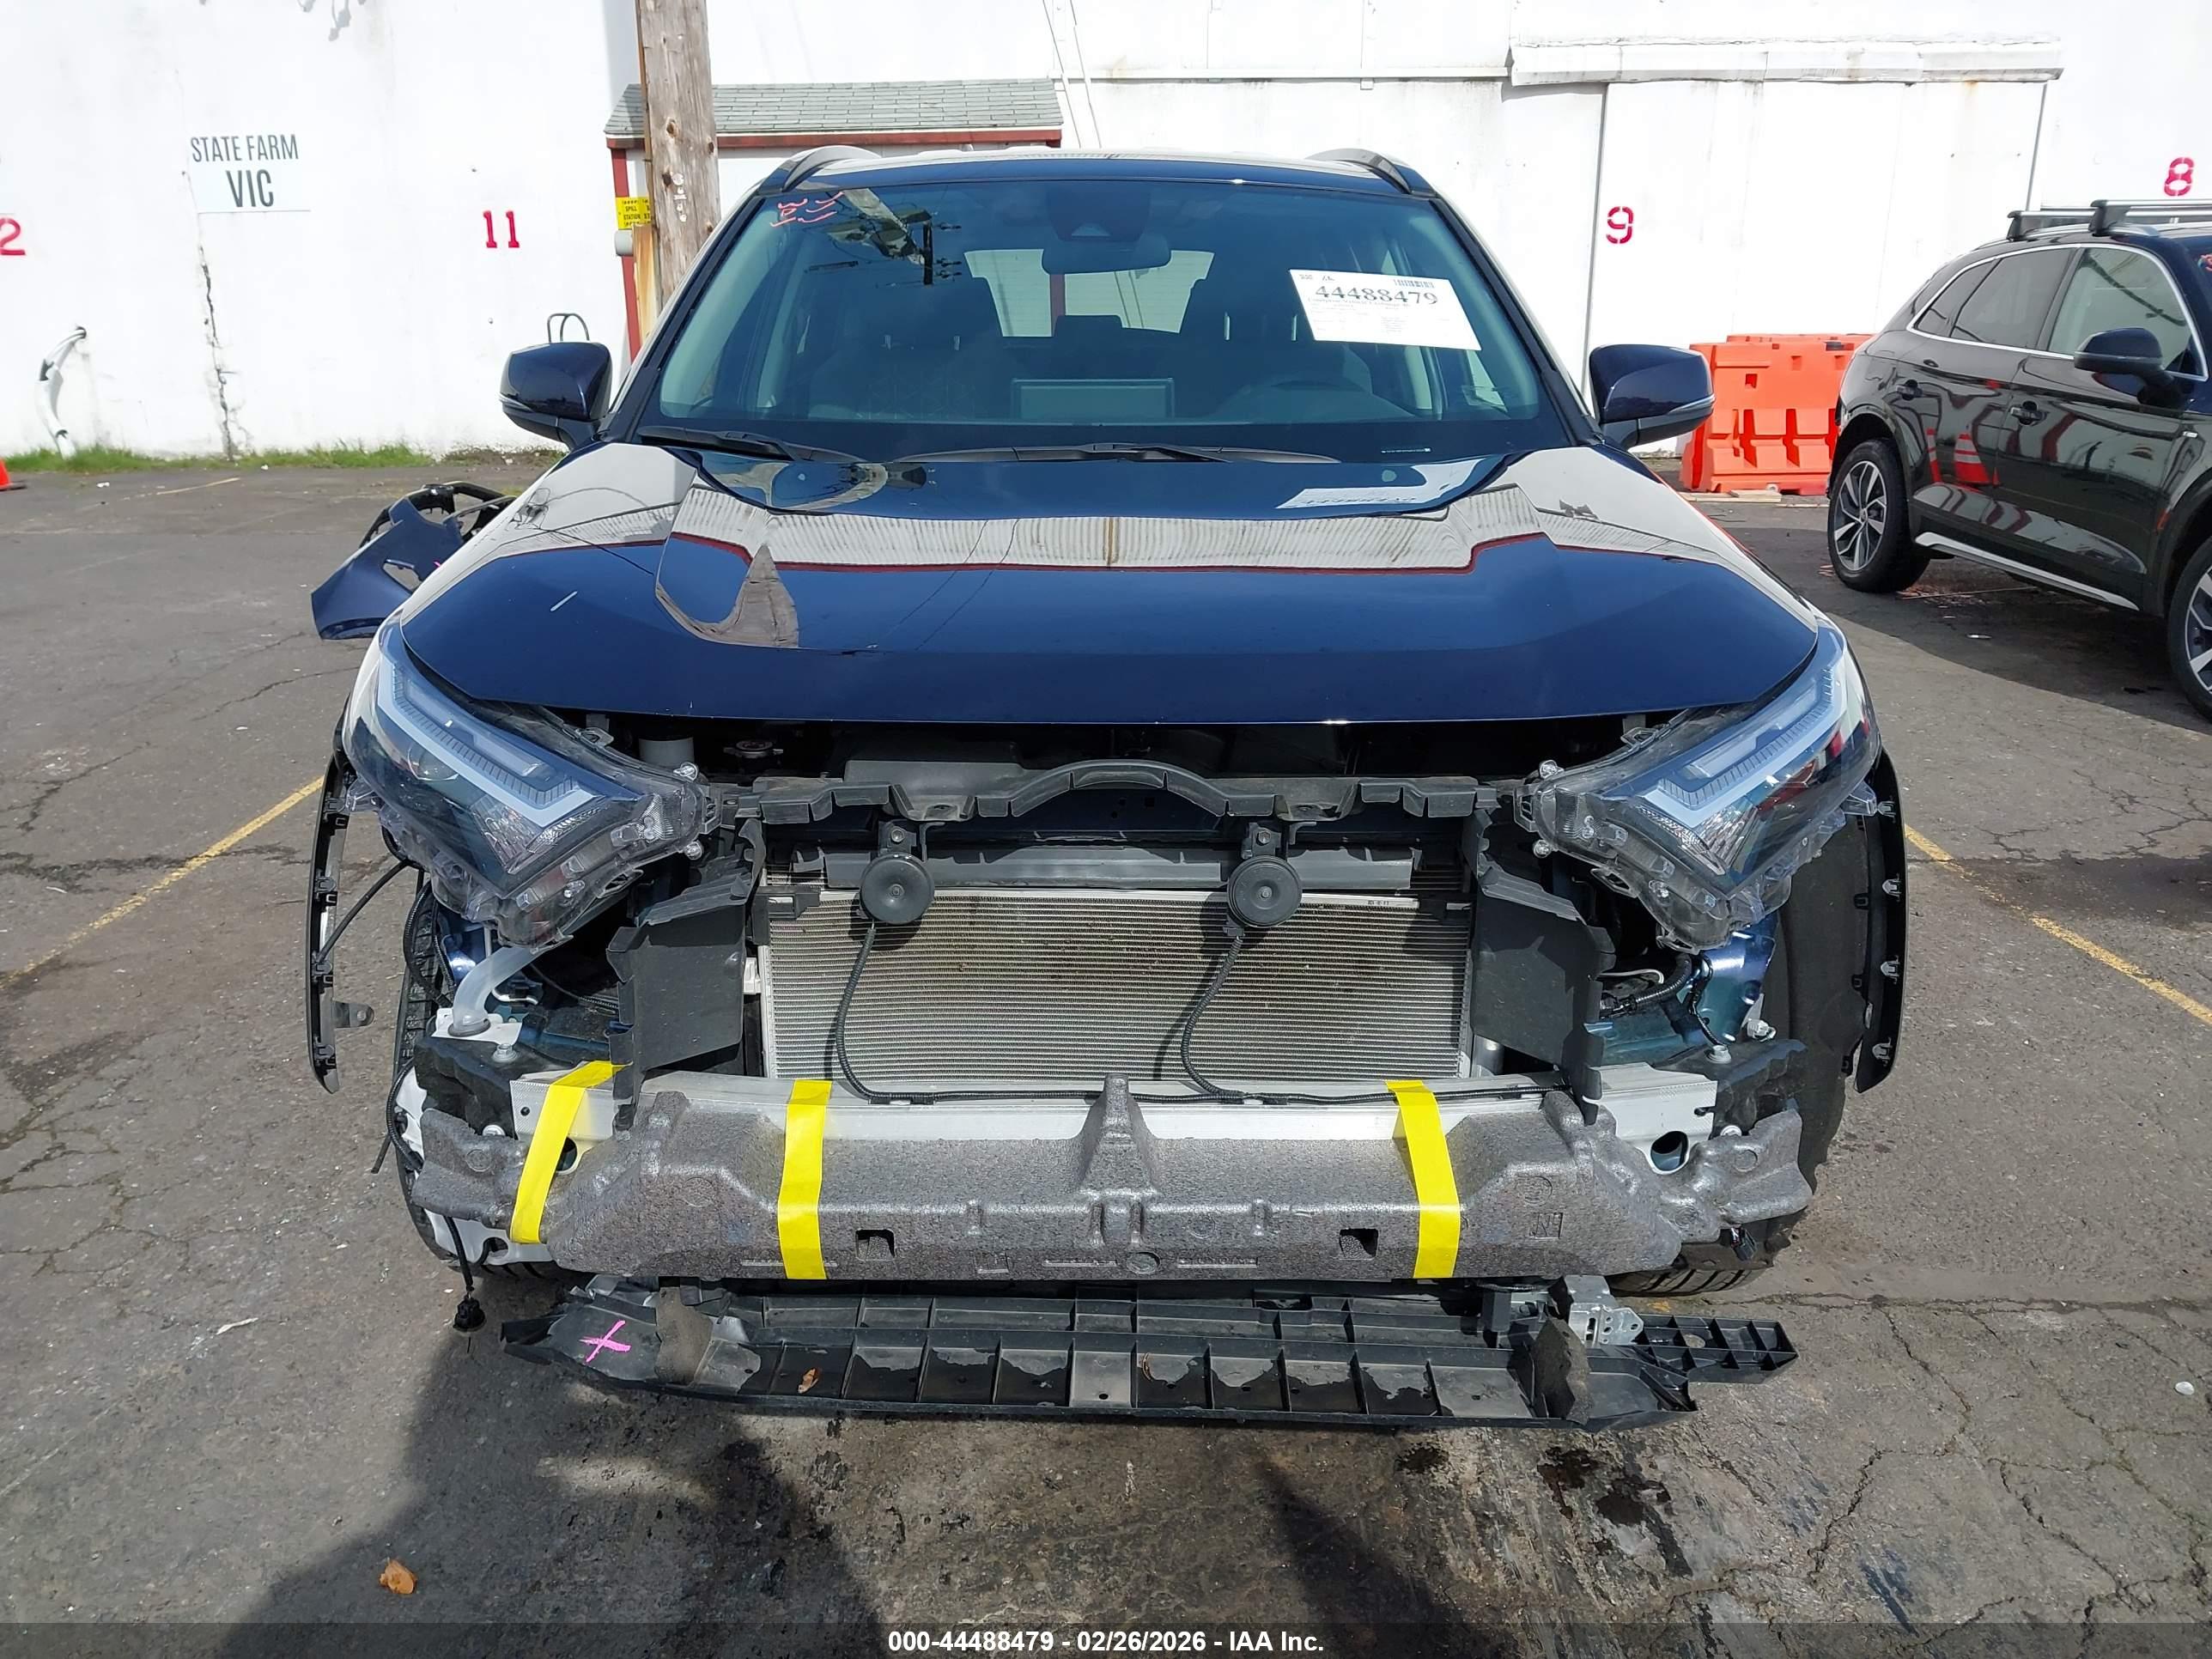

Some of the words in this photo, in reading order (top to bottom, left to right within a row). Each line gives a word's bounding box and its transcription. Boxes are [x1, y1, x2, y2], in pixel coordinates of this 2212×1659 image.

[191, 136, 242, 162] STATE
[246, 134, 300, 161] FARM
[225, 169, 274, 208] VIC
[2164, 156, 2195, 197] 8
[0, 217, 26, 256] 2
[483, 210, 520, 248] 11
[1606, 206, 1634, 244] 9
[1315, 285, 1439, 306] 44488479
